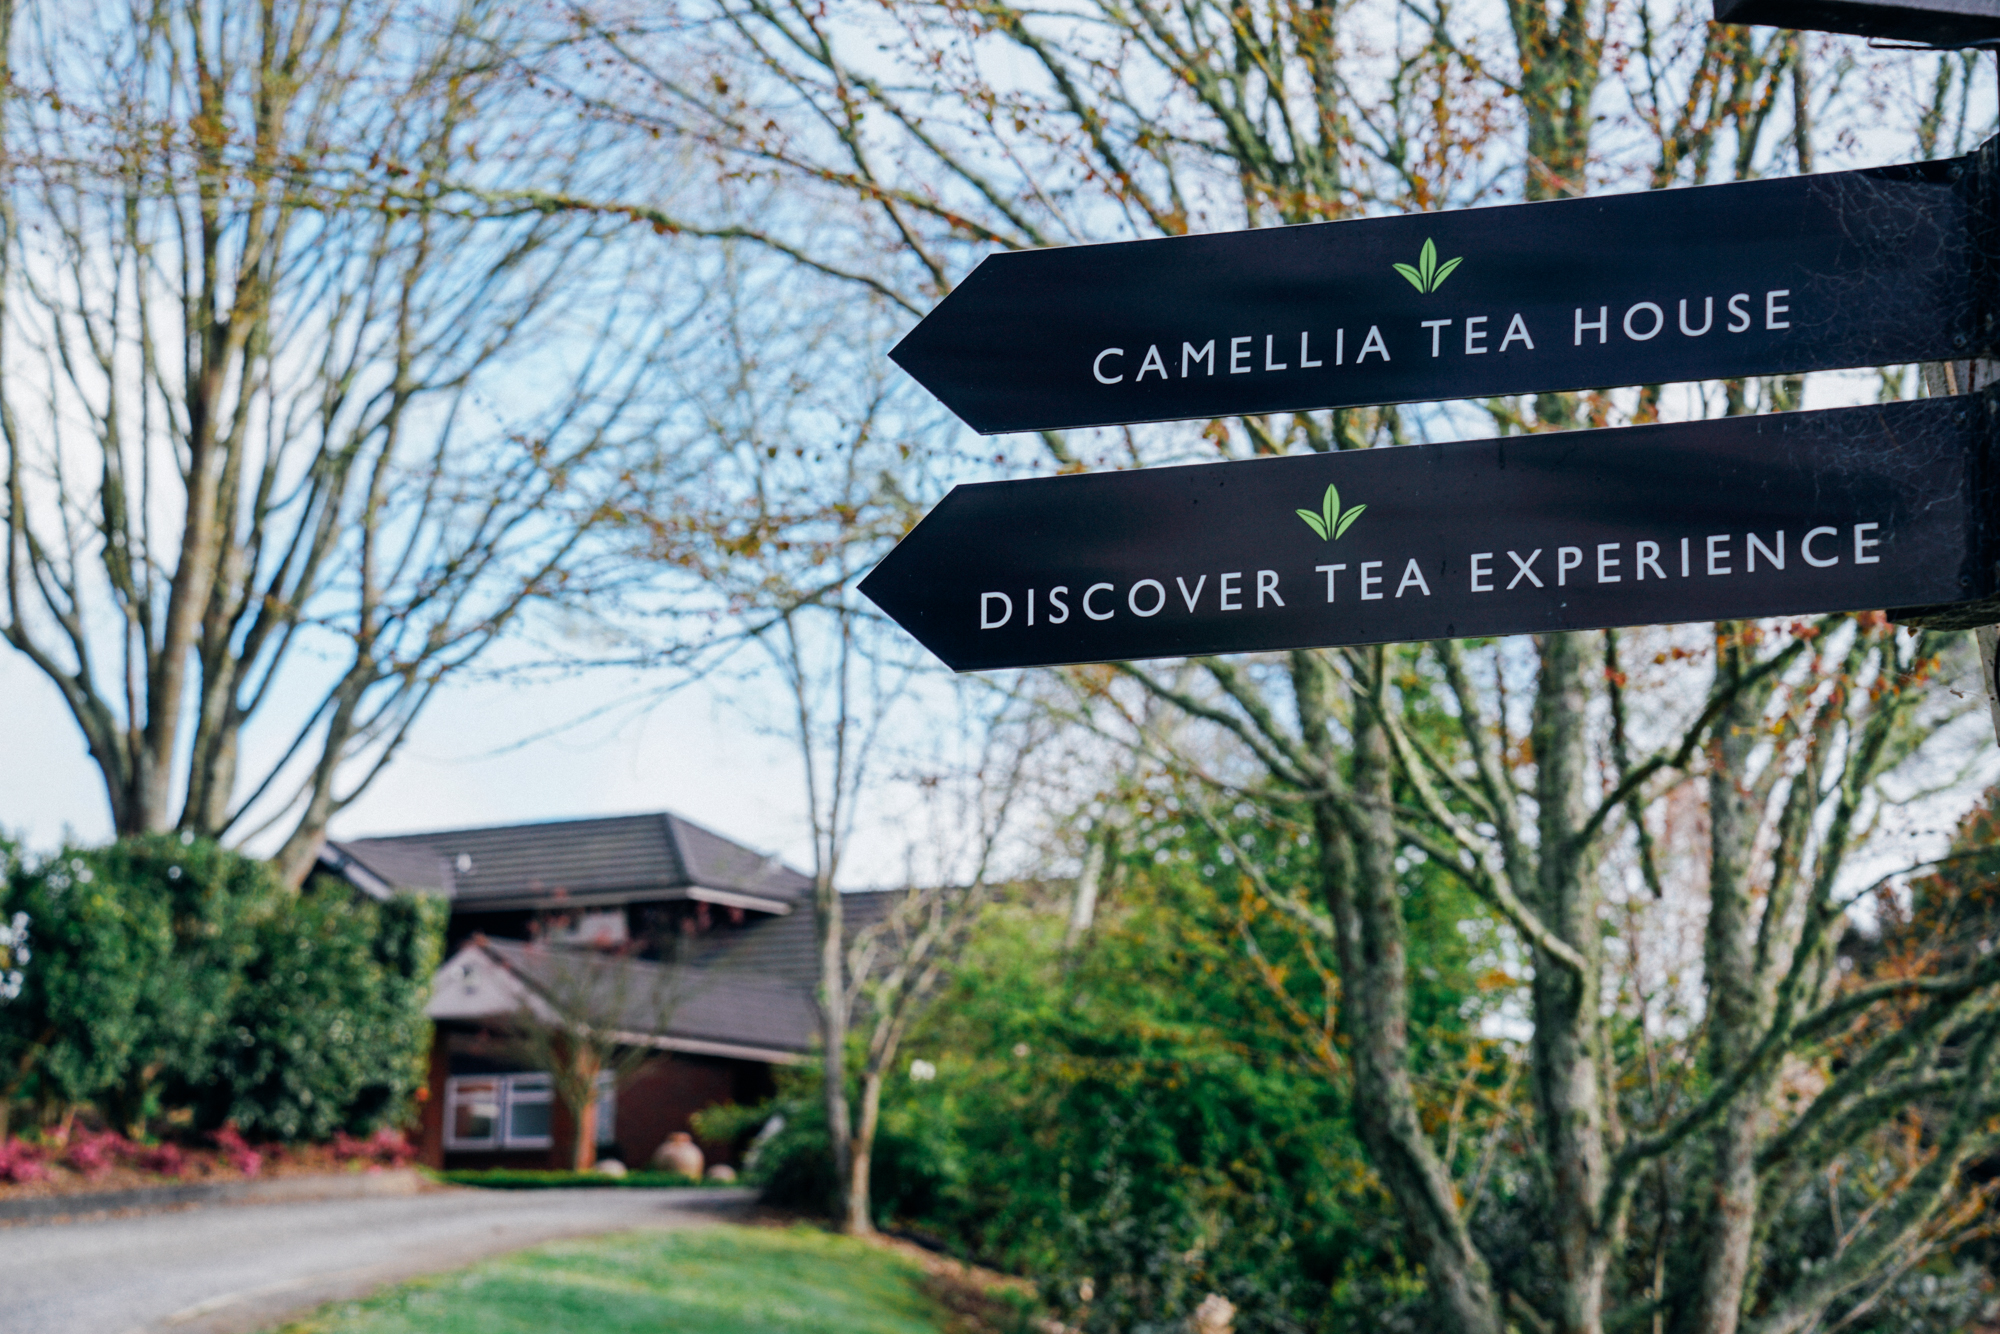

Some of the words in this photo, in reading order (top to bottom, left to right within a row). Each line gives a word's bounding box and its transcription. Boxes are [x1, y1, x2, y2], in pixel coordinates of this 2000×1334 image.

[1092, 325, 1391, 385] CAMELLIA
[1420, 313, 1535, 358] TEA
[1574, 289, 1793, 347] HOUSE
[979, 569, 1286, 631] DISCOVER
[1315, 558, 1431, 604] TEA
[1470, 521, 1881, 594] EXPERIENCE
